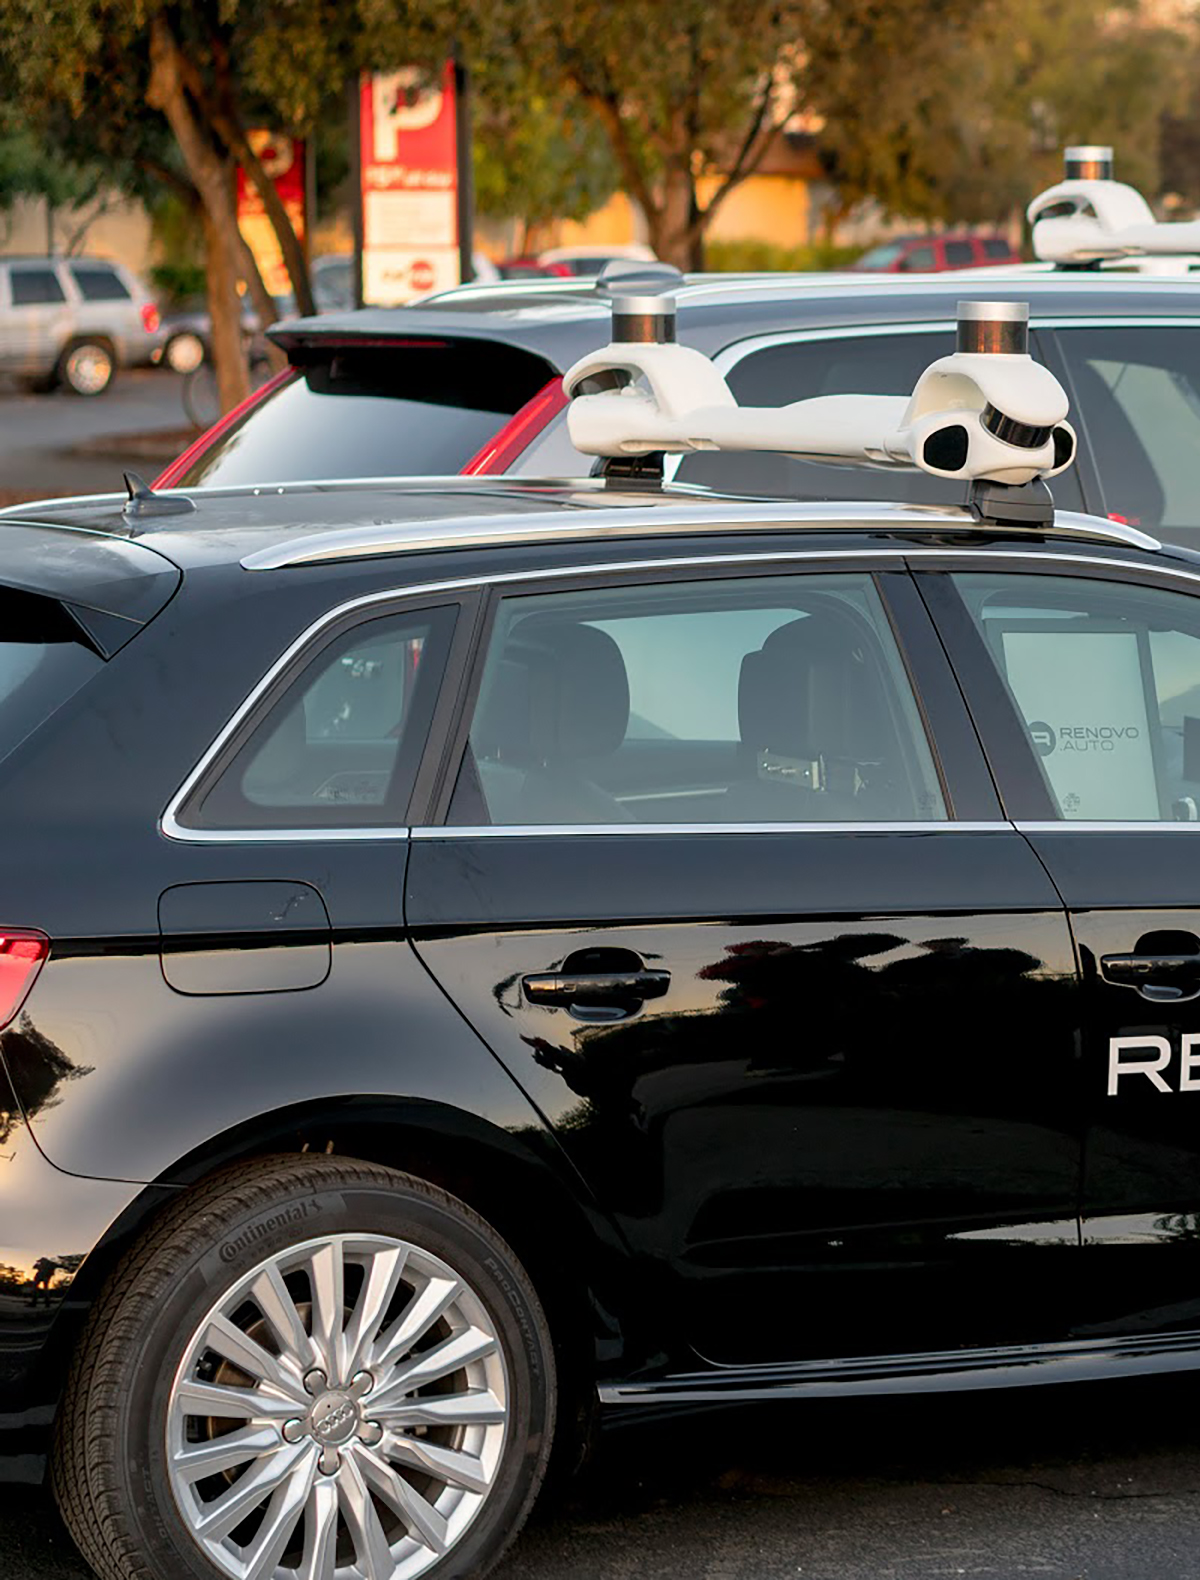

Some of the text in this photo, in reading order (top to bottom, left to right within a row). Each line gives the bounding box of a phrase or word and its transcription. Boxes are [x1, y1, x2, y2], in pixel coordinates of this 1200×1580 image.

[373, 65, 443, 162] P
[1060, 727, 1139, 739] RENOVO
[1060, 740, 1114, 751] .AUTO
[219, 1202, 309, 1263] Continental
